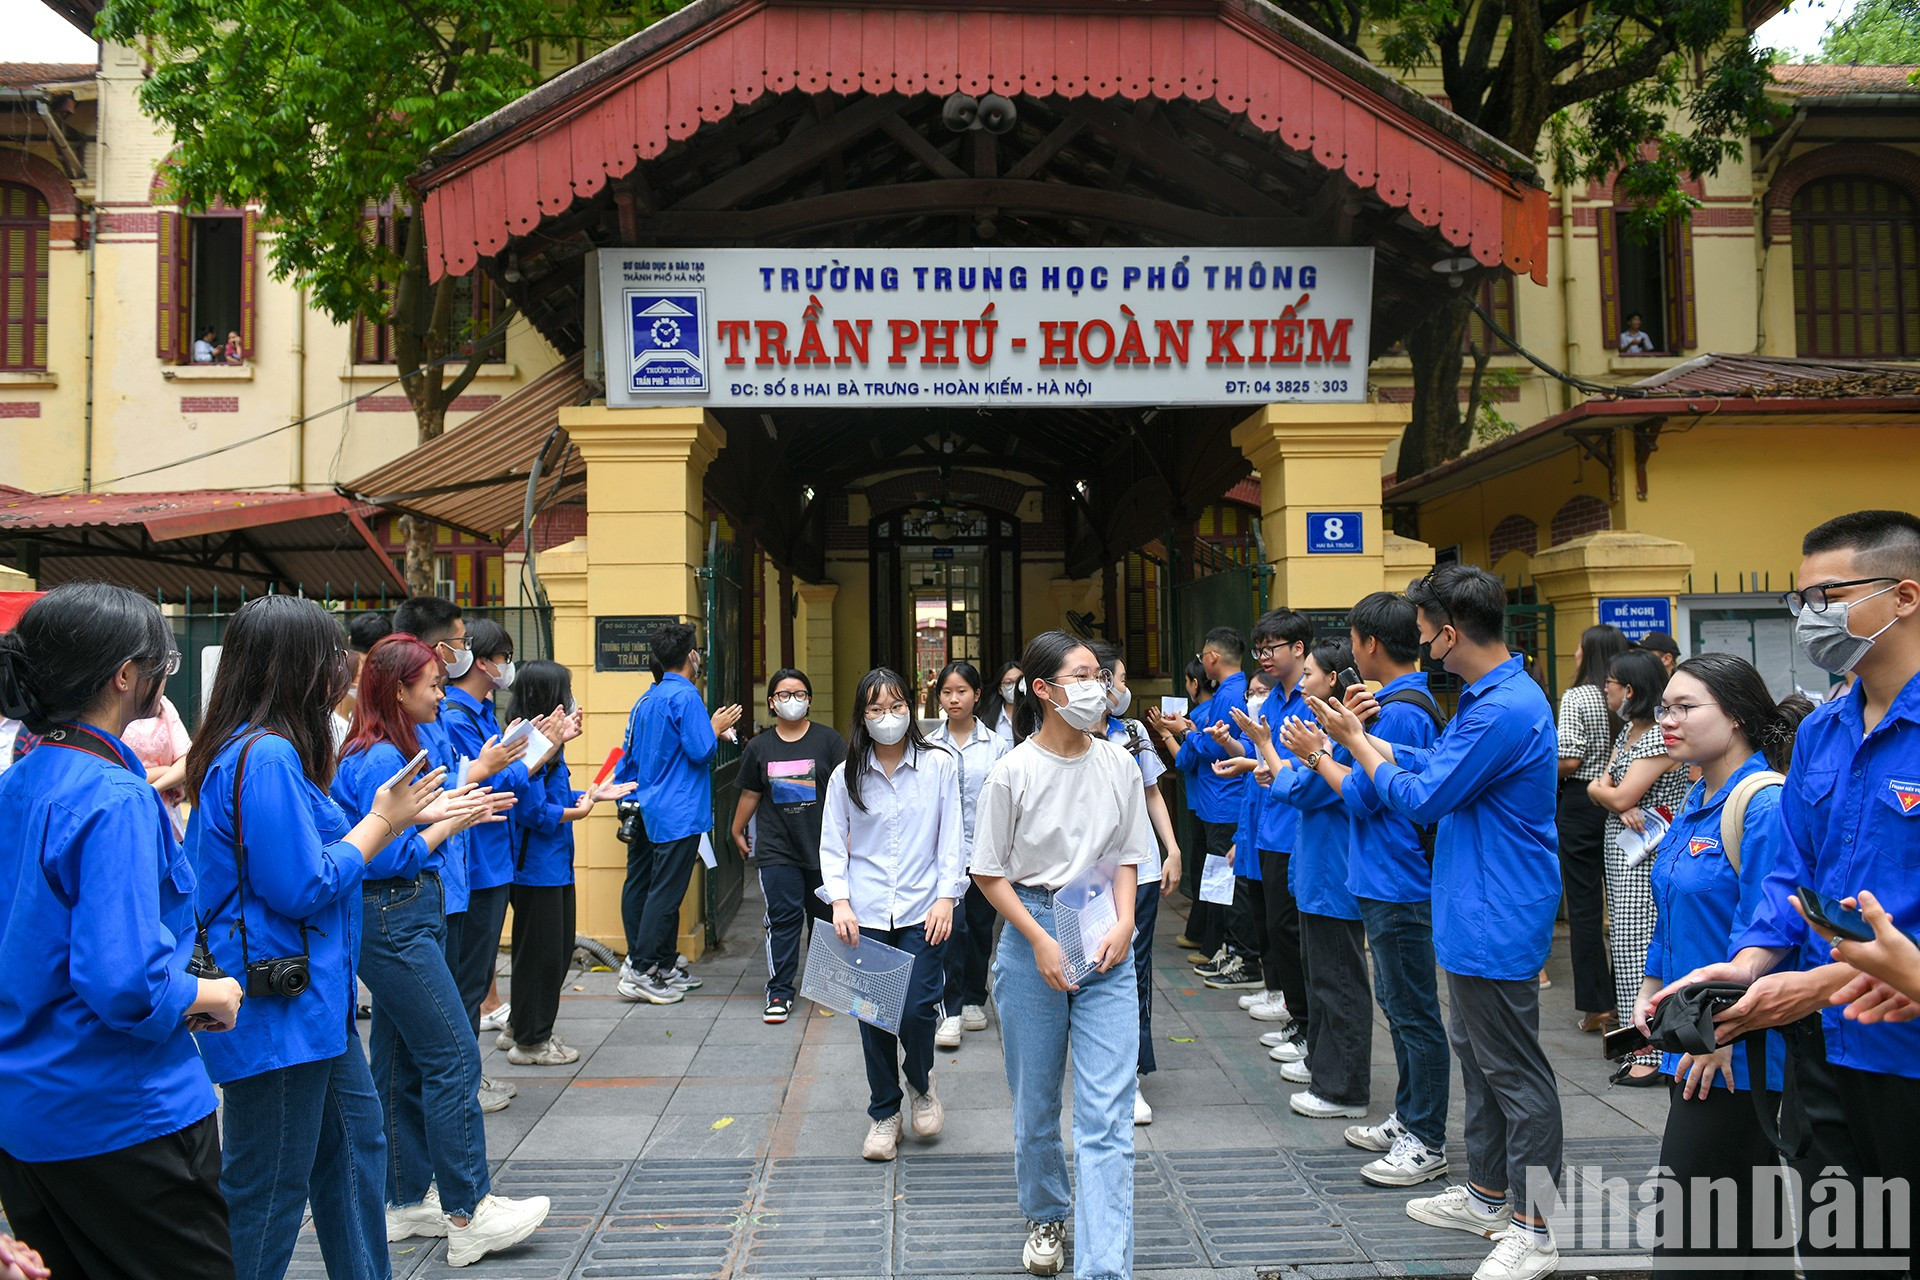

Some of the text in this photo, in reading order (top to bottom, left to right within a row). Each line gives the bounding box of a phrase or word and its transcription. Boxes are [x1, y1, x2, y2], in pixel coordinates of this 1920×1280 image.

[691, 262, 704, 271] TẠO
[623, 272, 704, 282] THÀNH PHỐ HÀ NỘI
[759, 256, 1318, 295] TRƯỜNG TRUNG HỌC PHỔ THÔNG
[717, 295, 873, 365] TRẦN
[887, 303, 999, 365] PHÚ
[1039, 304, 1194, 365] HOÀN
[1206, 293, 1353, 364] KIẾM
[731, 384, 758, 396] ĐC:
[764, 377, 786, 395] SỐ
[791, 384, 799, 395] 8
[804, 383, 830, 395] HAI
[838, 380, 859, 395] BÀ
[864, 382, 919, 395] TRƯNG
[934, 380, 979, 395] HOÀN
[985, 377, 1022, 395] KIẾM
[1037, 379, 1060, 395] HÀ
[1065, 379, 1091, 398] NỘI
[1226, 381, 1250, 393] ĐT:
[1254, 381, 1271, 393] 04
[1276, 381, 1310, 393] 3825
[1324, 517, 1344, 541] 8
[1630, 607, 1655, 617] NGHỊ
